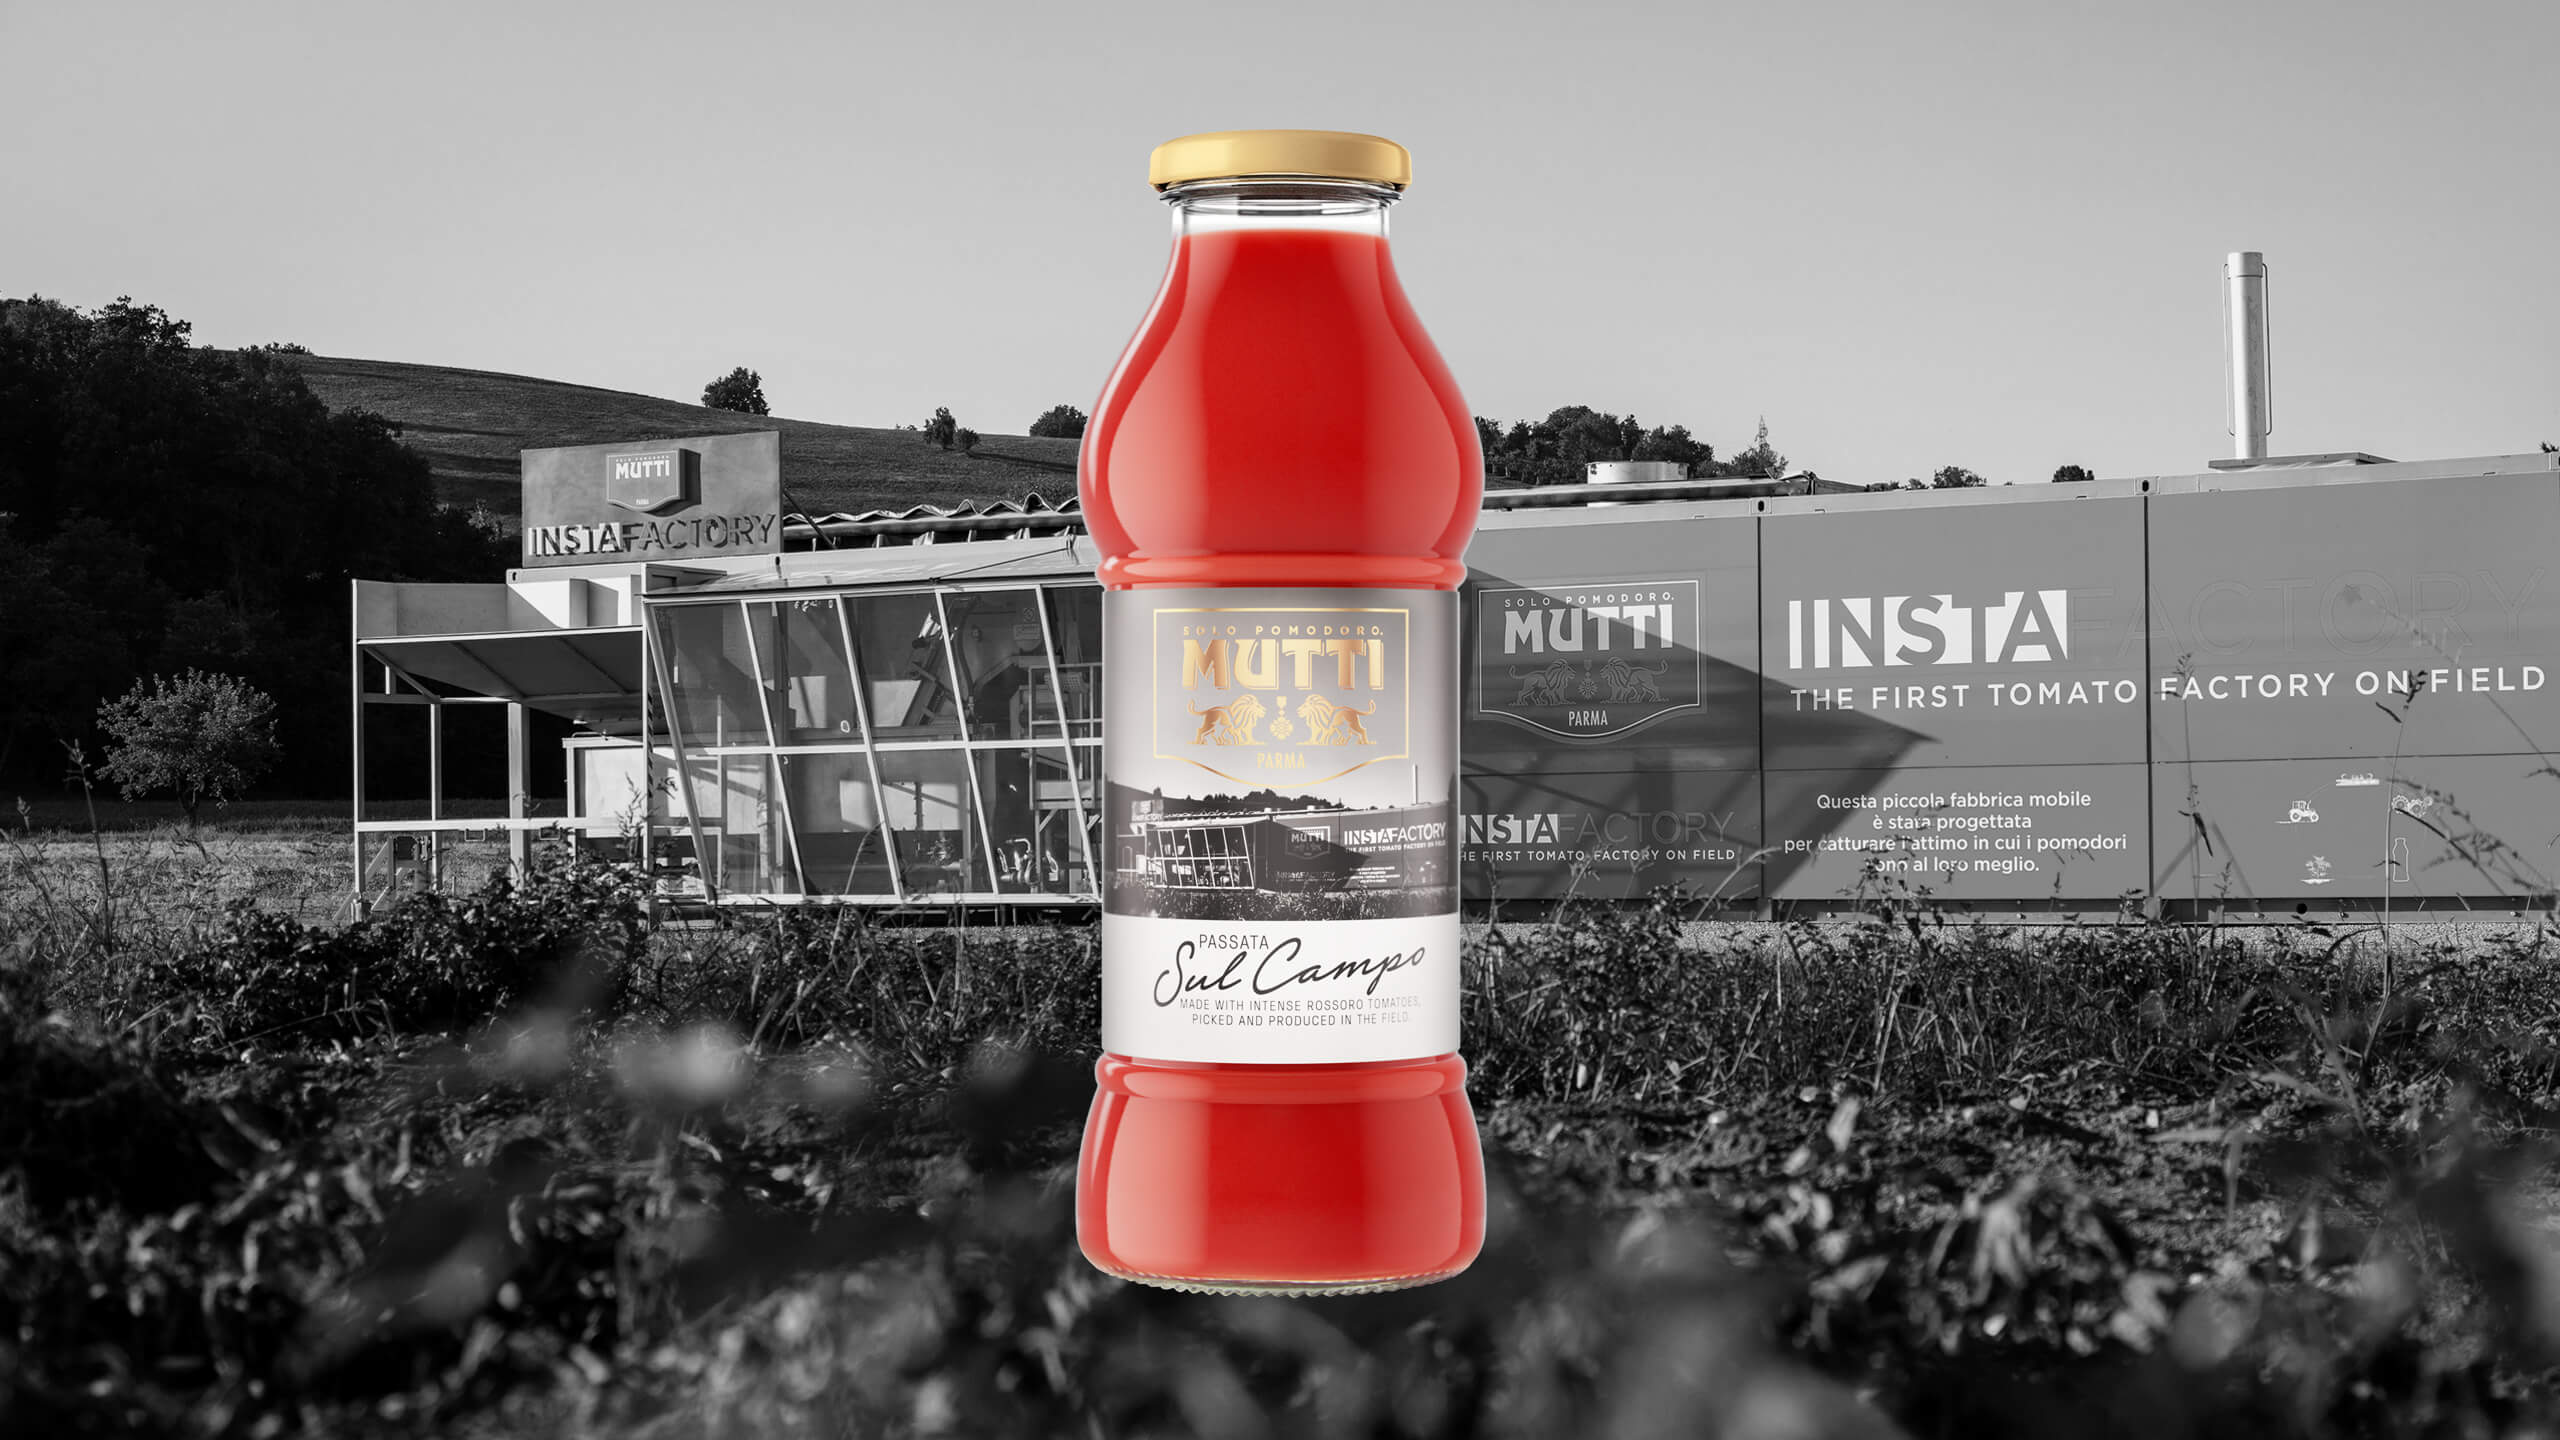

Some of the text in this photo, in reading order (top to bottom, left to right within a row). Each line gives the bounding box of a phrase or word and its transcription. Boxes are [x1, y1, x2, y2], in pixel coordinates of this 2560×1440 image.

[615, 460, 670, 480] MUTTI
[528, 514, 776, 557] INSTAFACTORY
[1504, 597, 1551, 608] SOLO
[1183, 625, 1237, 636] SOLO
[1504, 604, 1673, 654] MUTTI
[1182, 639, 1384, 690] MUTTI
[1790, 666, 2546, 711] THE FIRST TOMATO FACTORY ON FIELD
[1568, 709, 1609, 727] PARMA
[1256, 751, 1307, 770] PARMA
[1816, 791, 2092, 811] Questa piccola fabbrica mobile
[1459, 811, 1735, 845] NSTAFACTORY
[1872, 814, 2032, 832] è stata progettata
[1291, 831, 1325, 843] MUTTI
[1784, 838, 1812, 853] per
[1818, 836, 1896, 851] catturare
[1973, 835, 1989, 850] in
[1995, 835, 2021, 850] cui
[2026, 835, 2032, 850] i
[2037, 834, 2127, 853] pomodori
[1459, 849, 1736, 862] HE FIRST TOMATO FACTORY ON FIELD
[1867, 856, 2040, 875] ono al loro meglio.
[1199, 934, 1270, 950] PASSATA
[1154, 938, 1425, 1007] Sul Campo
[1179, 998, 1210, 1010] MADE
[1215, 999, 1244, 1011] WITH
[1250, 1000, 1301, 1011] INTENSE
[1307, 999, 1364, 1011] ROSSORO
[1192, 1013, 1233, 1026] PICKED
[1238, 1014, 1263, 1026] AND
[1268, 1014, 1336, 1026] PRODUCED
[1341, 1014, 1352, 1025] IN
[1357, 1013, 1377, 1025] THE
